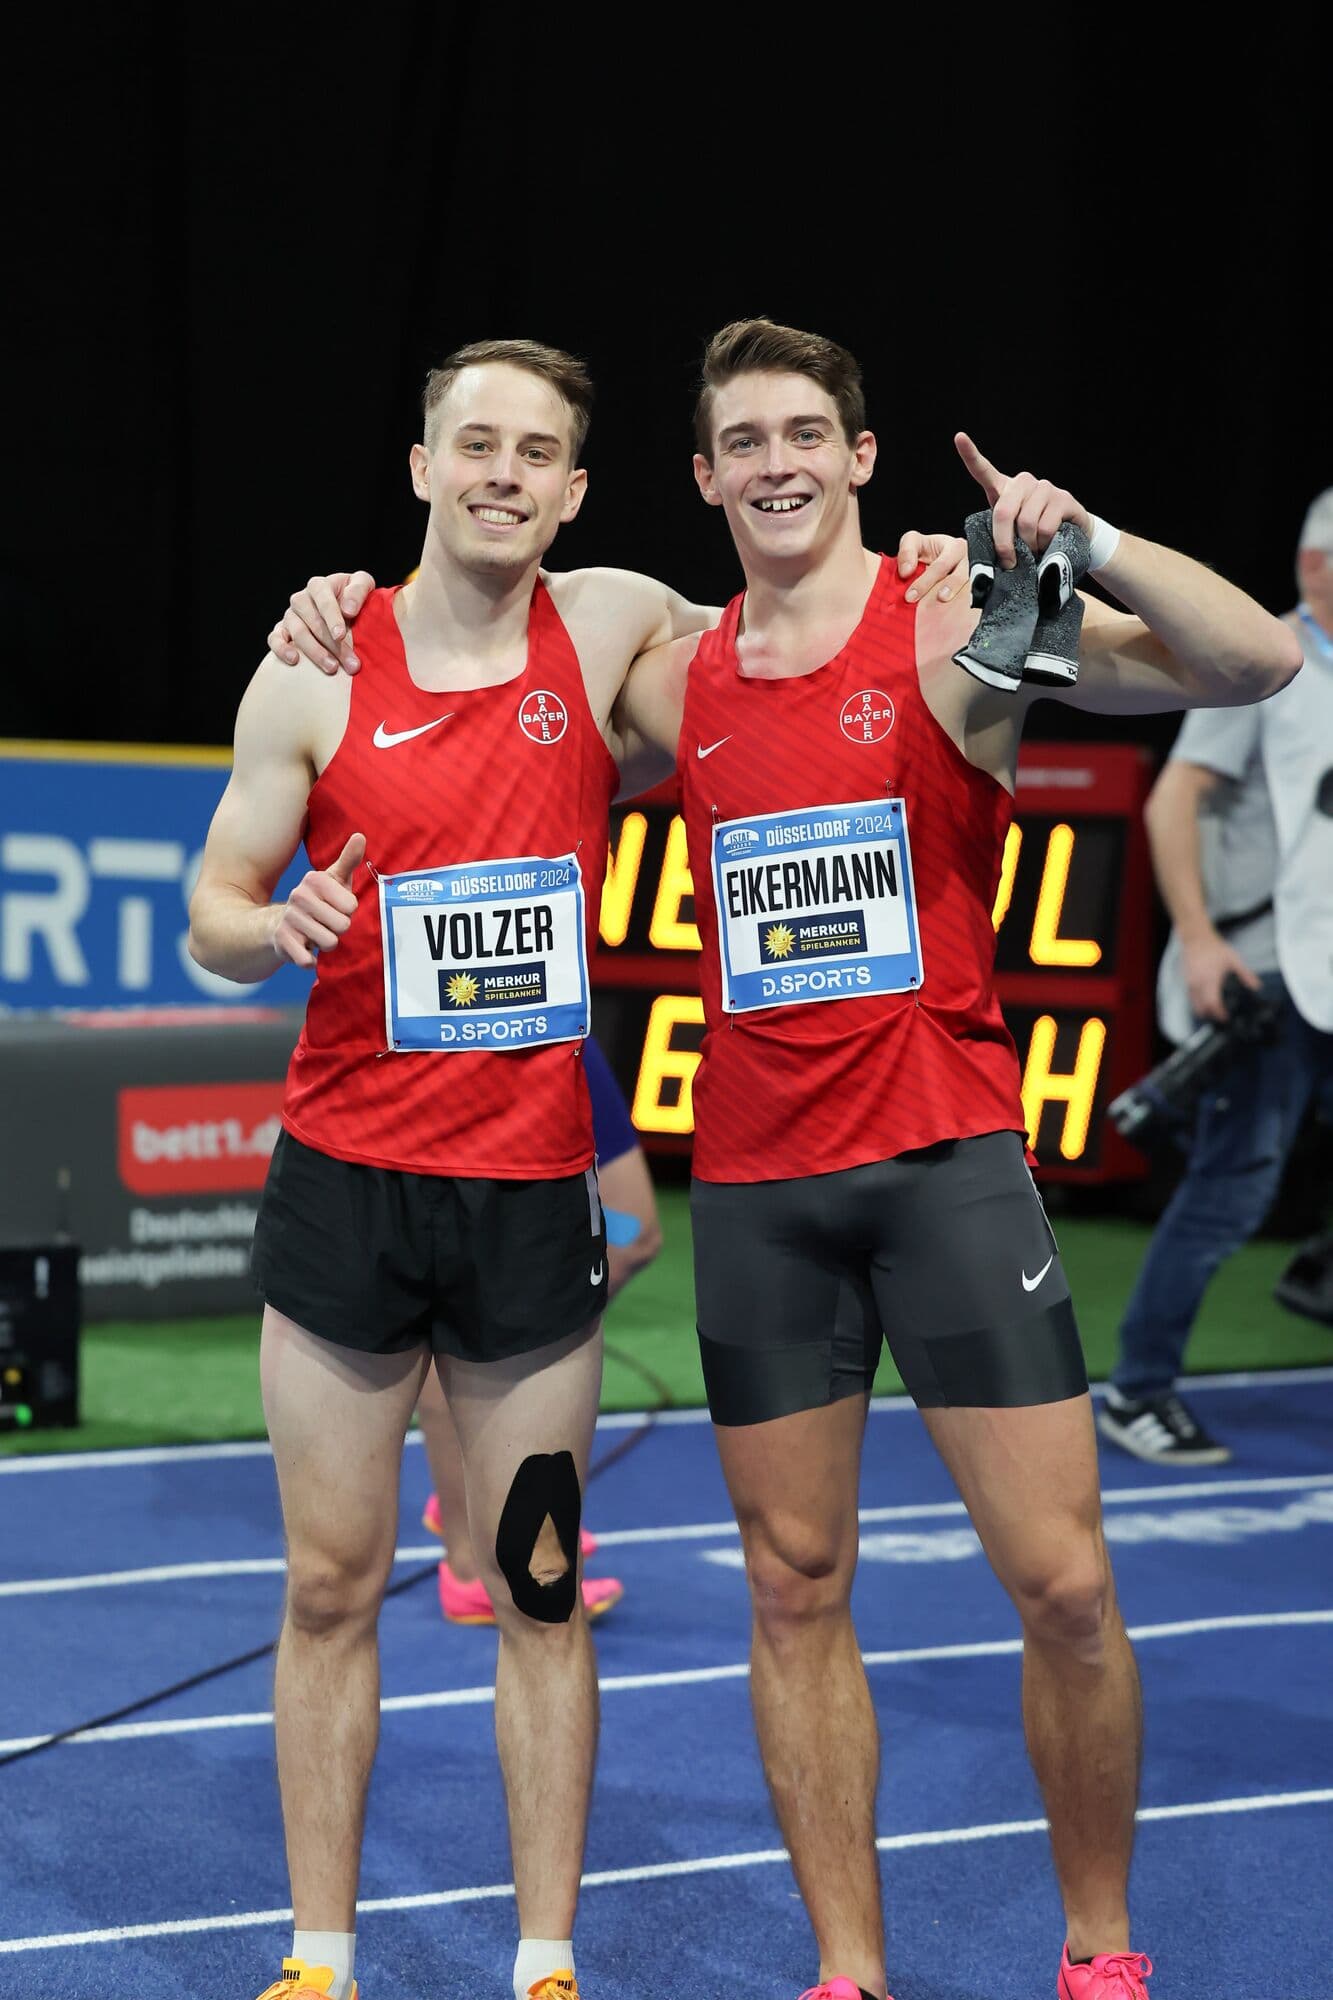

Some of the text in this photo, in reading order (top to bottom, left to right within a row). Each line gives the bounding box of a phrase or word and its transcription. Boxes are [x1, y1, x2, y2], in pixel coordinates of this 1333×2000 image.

[523, 711, 565, 724] BAYER
[537, 695, 552, 740] BAYER
[843, 709, 892, 724] BAYER
[862, 694, 874, 740] BAYER
[766, 815, 893, 847] DÜSSELDORF 2024
[451, 868, 570, 897] DÜSSELDORF 2024
[726, 849, 898, 918] EIKERMANN
[423, 904, 554, 961] VOLZER
[800, 921, 859, 939] MERKUR
[800, 937, 861, 951] SPIELBANKEN
[484, 973, 541, 988] MERKUR
[484, 988, 542, 1001] SPIELBANKEN
[762, 966, 872, 997] D.SPORTS
[440, 1015, 548, 1042] D.SPORTS
